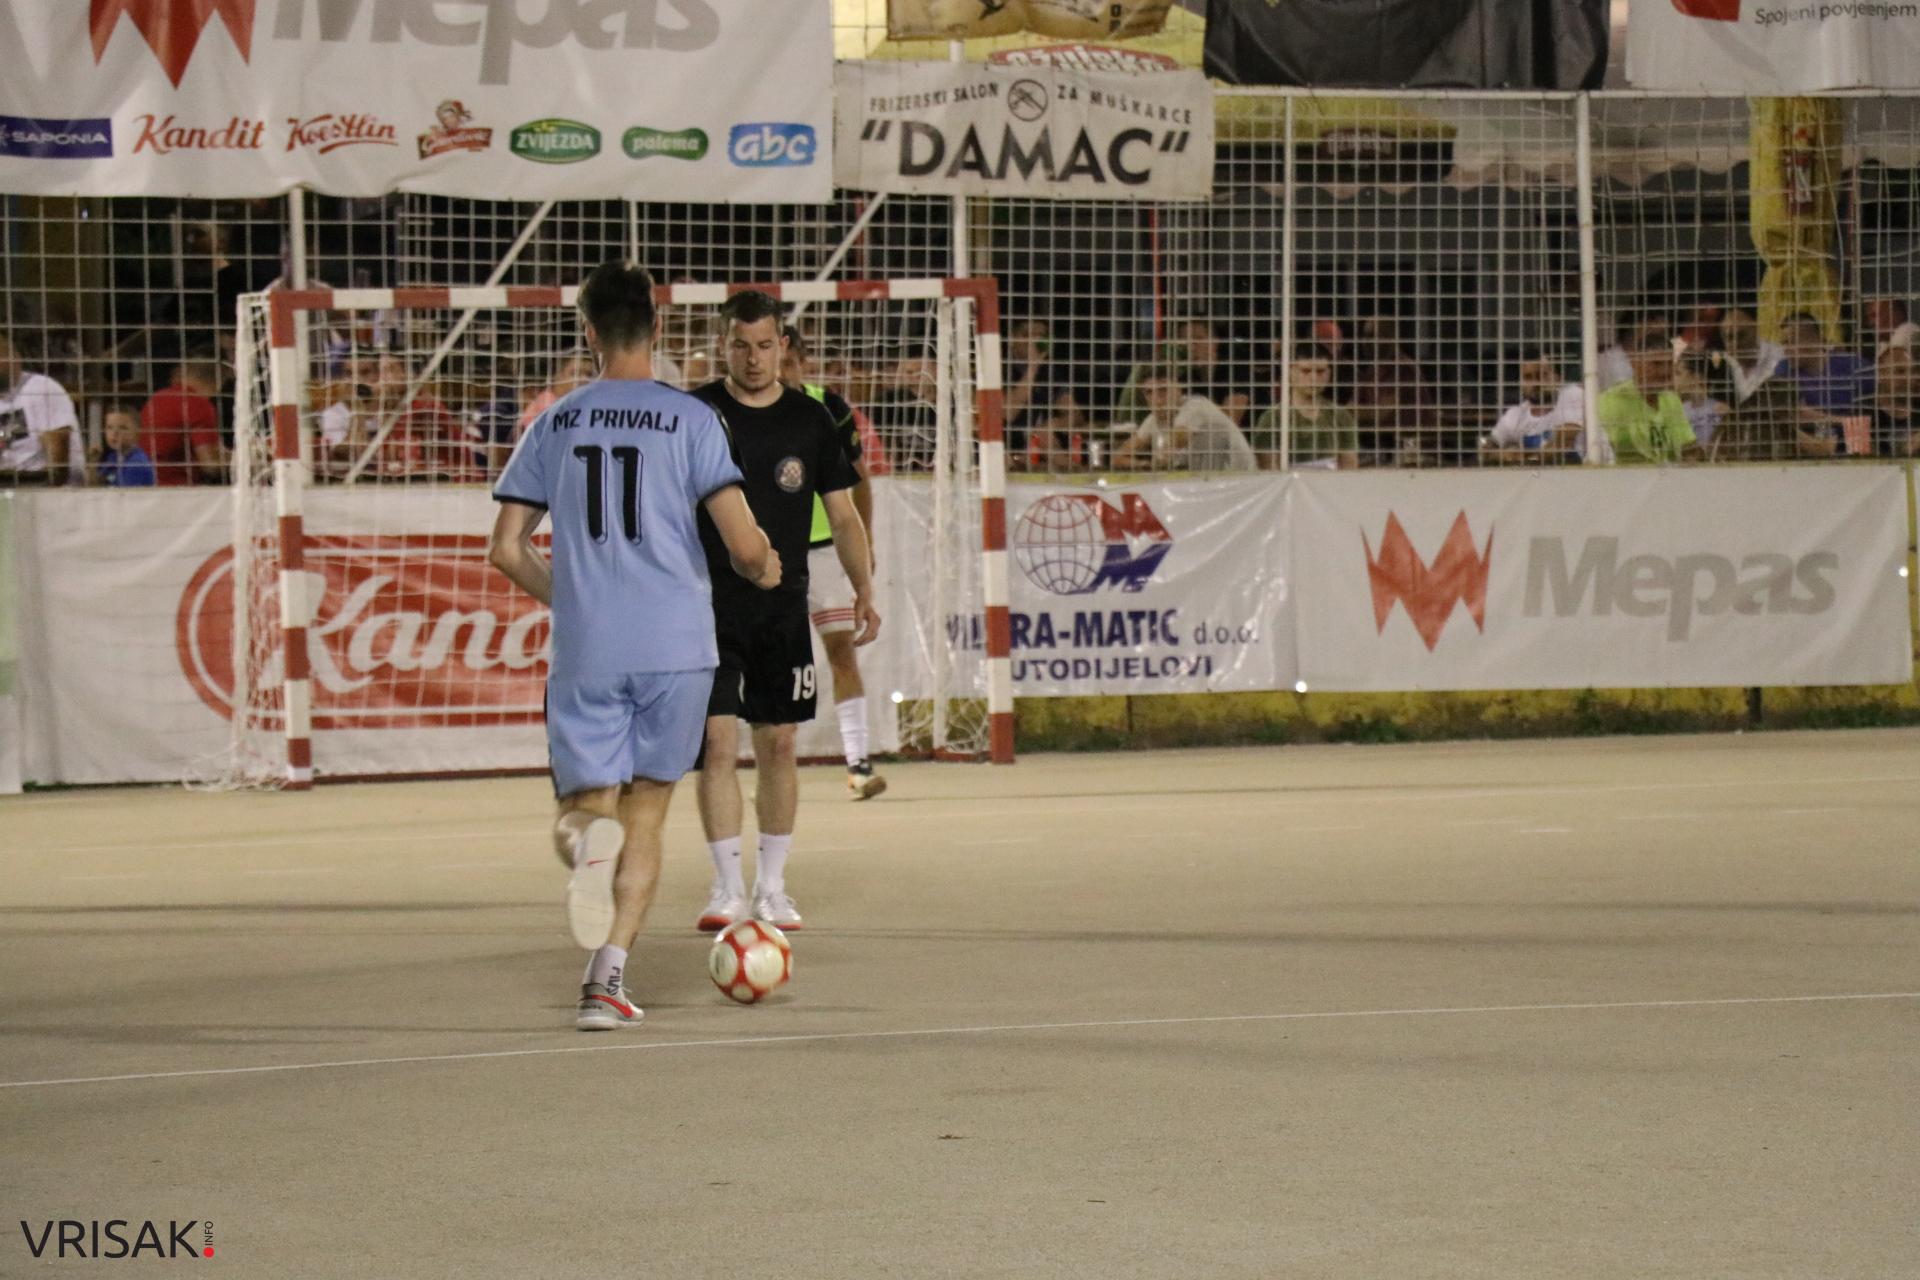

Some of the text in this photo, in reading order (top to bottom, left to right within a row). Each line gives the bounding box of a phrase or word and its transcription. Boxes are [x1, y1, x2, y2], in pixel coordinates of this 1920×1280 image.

[1754, 4, 1816, 27] Spojeni
[869, 81, 1192, 125] FRIZERSKI SALON ZA MUŠKARCE
[11, 130, 109, 146] SAPONIA
[131, 113, 265, 155] Kandit
[516, 131, 595, 153] ZVIJEZDA
[733, 126, 809, 162] abc
[552, 409, 679, 435] MZ PRIVALJ
[573, 445, 644, 546] 11
[1522, 535, 1840, 642] Mepas
[944, 608, 1260, 651] VILRA-MATIC d.o.o.
[792, 663, 816, 702] 19
[1009, 655, 1213, 682] UTODIJELOVI
